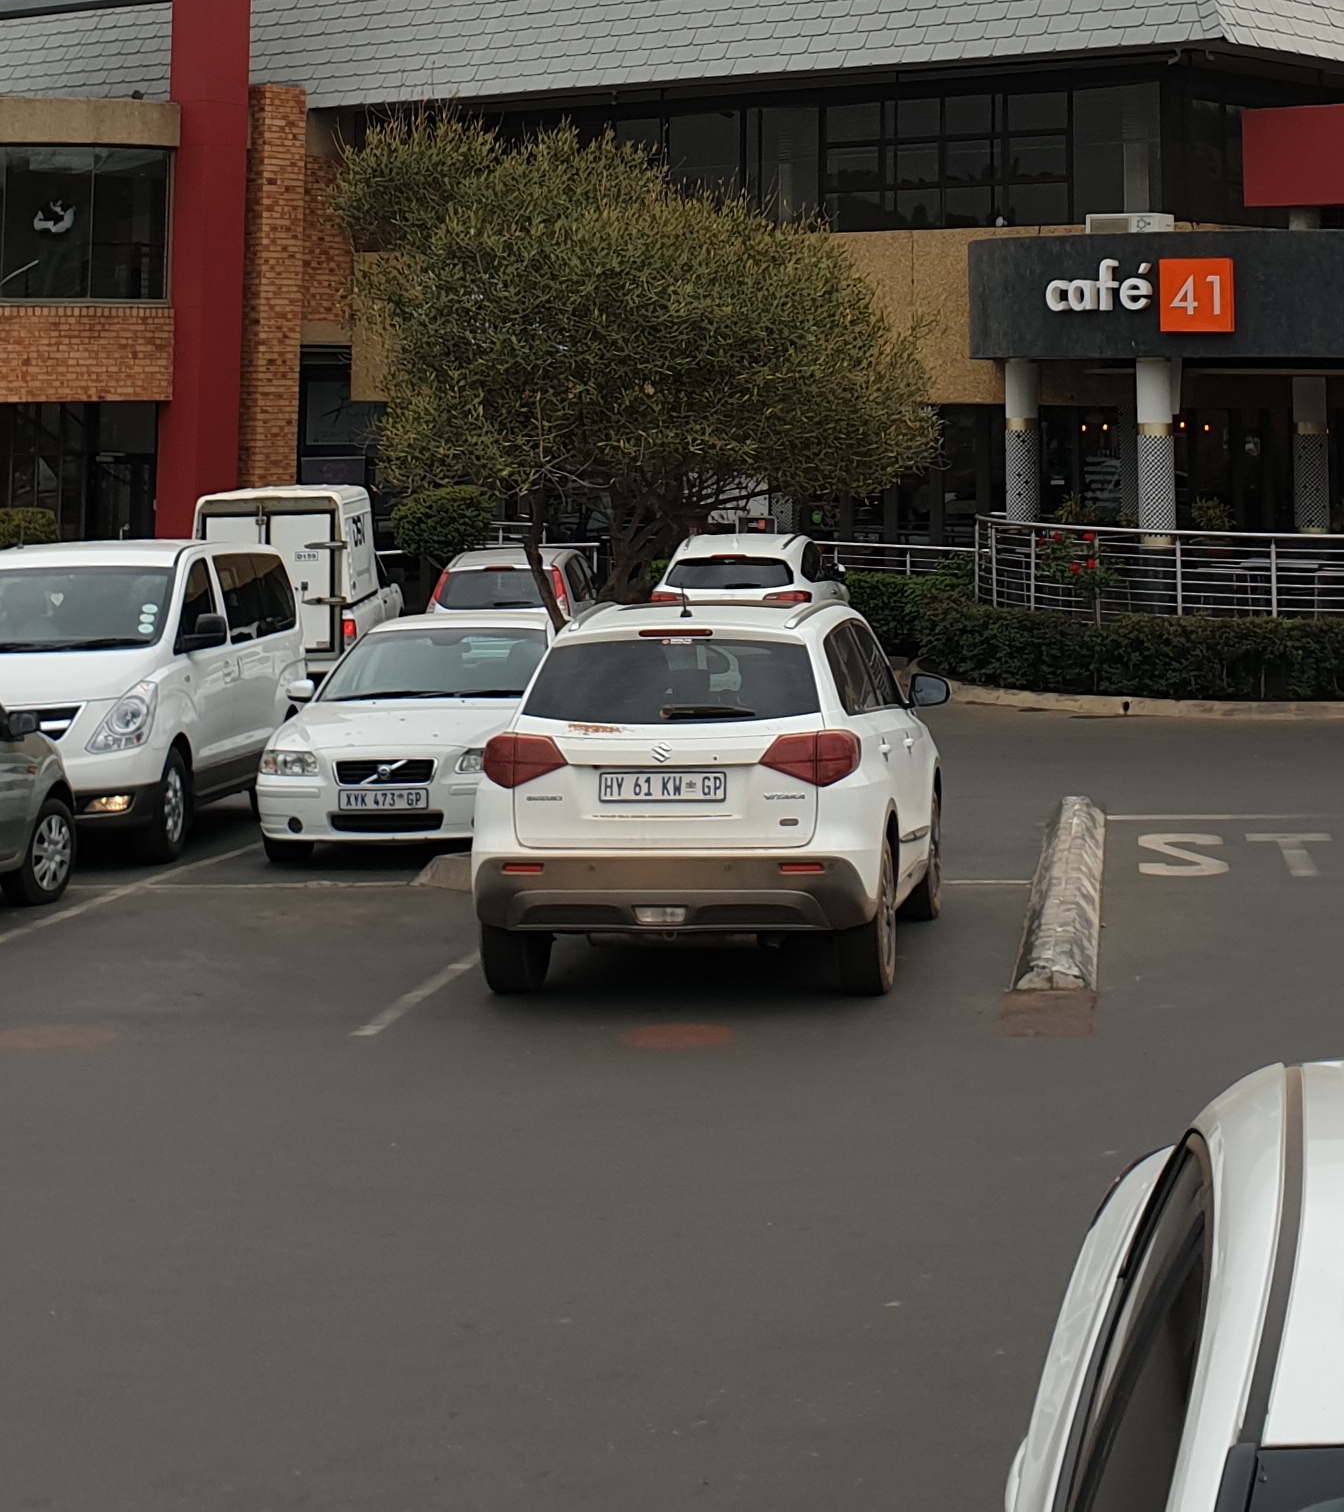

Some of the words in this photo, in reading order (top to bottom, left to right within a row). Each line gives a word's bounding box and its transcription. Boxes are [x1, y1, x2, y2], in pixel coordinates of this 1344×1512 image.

[1045, 258, 1153, 312] café
[1169, 275, 1221, 316] 41
[604, 776, 625, 798] HY
[633, 777, 653, 797] 61
[661, 776, 683, 797] KW
[702, 776, 723, 797] GP
[373, 792, 396, 807] 473
[406, 791, 422, 807] GP
